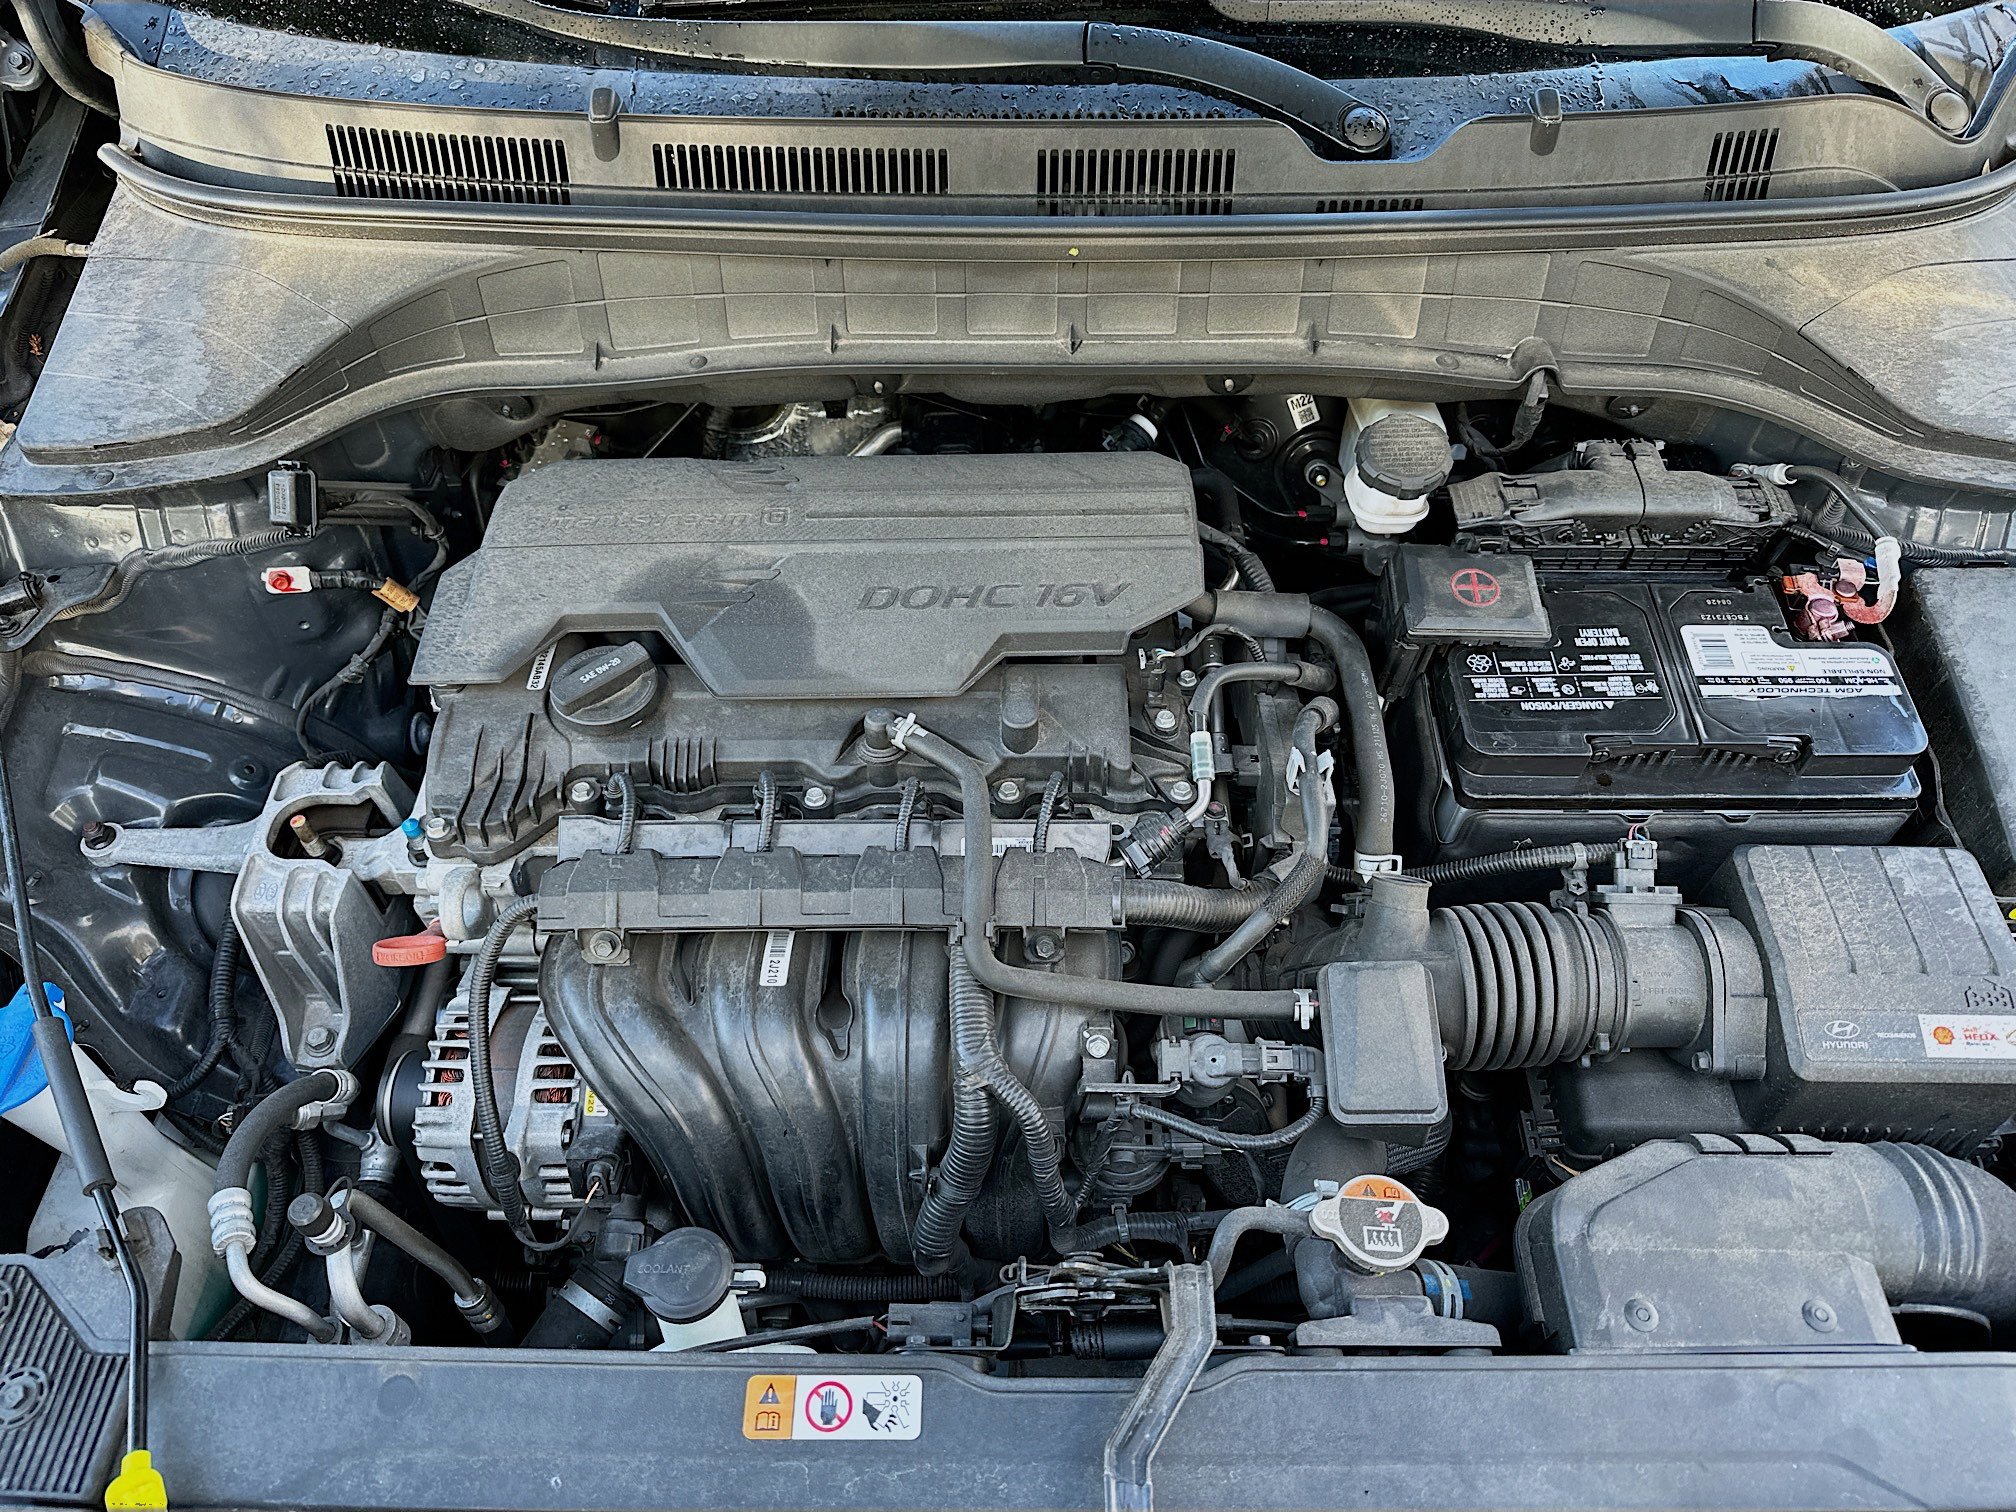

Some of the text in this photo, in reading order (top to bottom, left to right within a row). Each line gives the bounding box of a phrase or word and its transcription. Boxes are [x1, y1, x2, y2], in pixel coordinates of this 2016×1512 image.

[857, 582, 1131, 610] DOHC 16V
[1578, 628, 1620, 637] BATTERY!
[1574, 636, 1630, 647] DO NOT OPEN
[579, 670, 597, 684] SAE
[595, 657, 621, 675] 0W-20
[1520, 700, 1604, 711] DANGER/POISON
[767, 960, 780, 983] 2J210
[1963, 1033, 1999, 1041] HELIX
[1822, 1041, 1869, 1049] HYUNDAI
[637, 1264, 690, 1274] COOLANT
